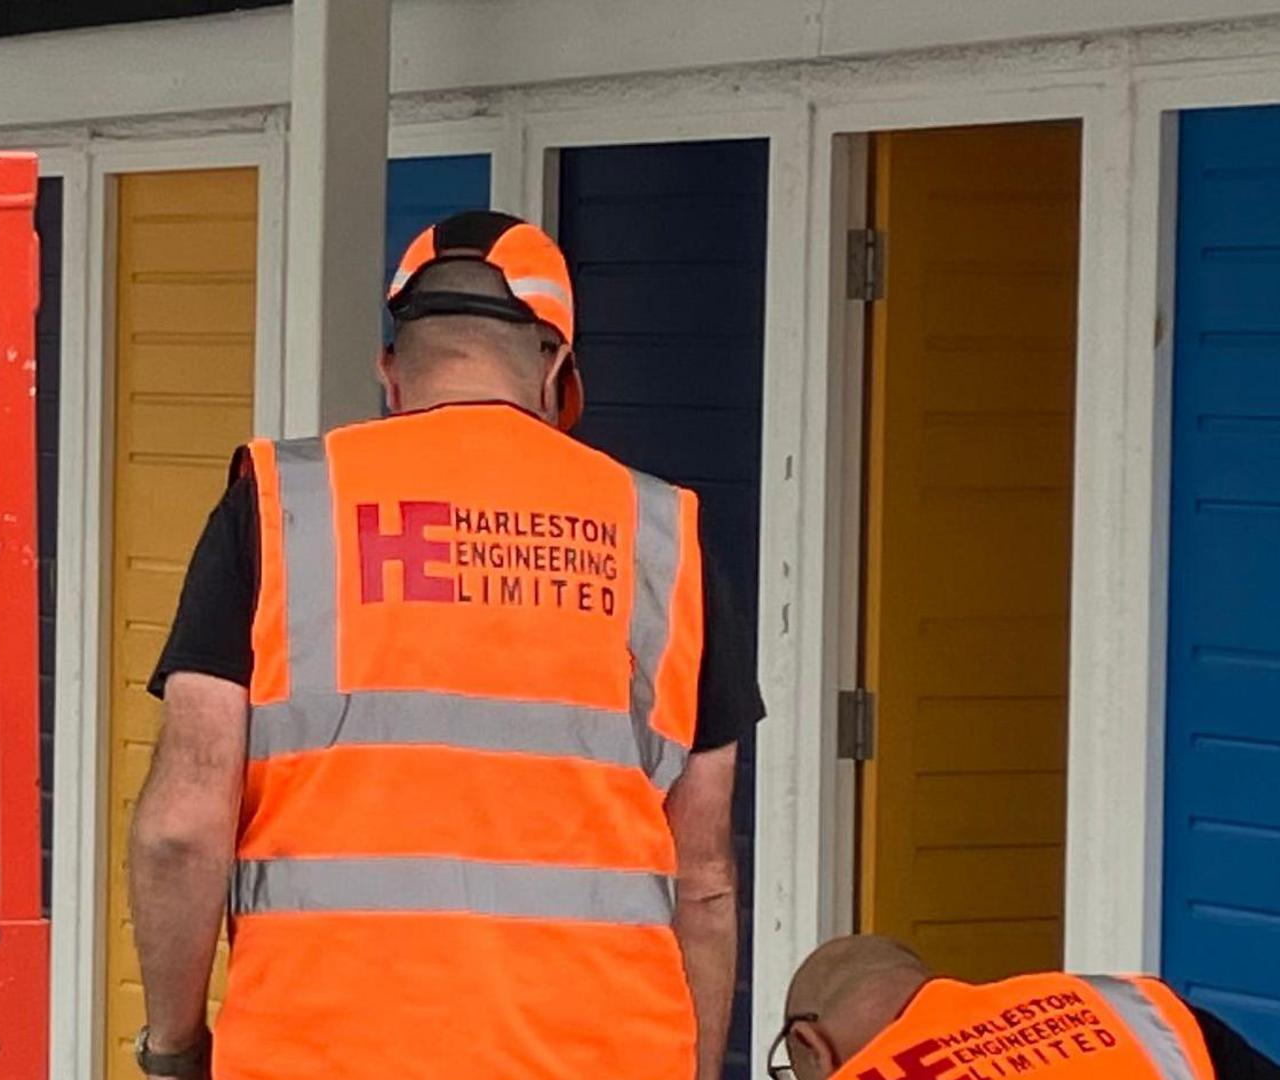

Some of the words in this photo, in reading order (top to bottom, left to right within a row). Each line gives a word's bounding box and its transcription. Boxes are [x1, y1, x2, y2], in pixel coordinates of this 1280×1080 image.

[455, 507, 617, 549] HARLESTON
[356, 501, 454, 605] HE
[455, 541, 617, 580] ENGINEERING
[458, 574, 615, 616] LIMITED
[937, 991, 1084, 1048] HARLESTON
[952, 1009, 1101, 1065] ENGINEERING
